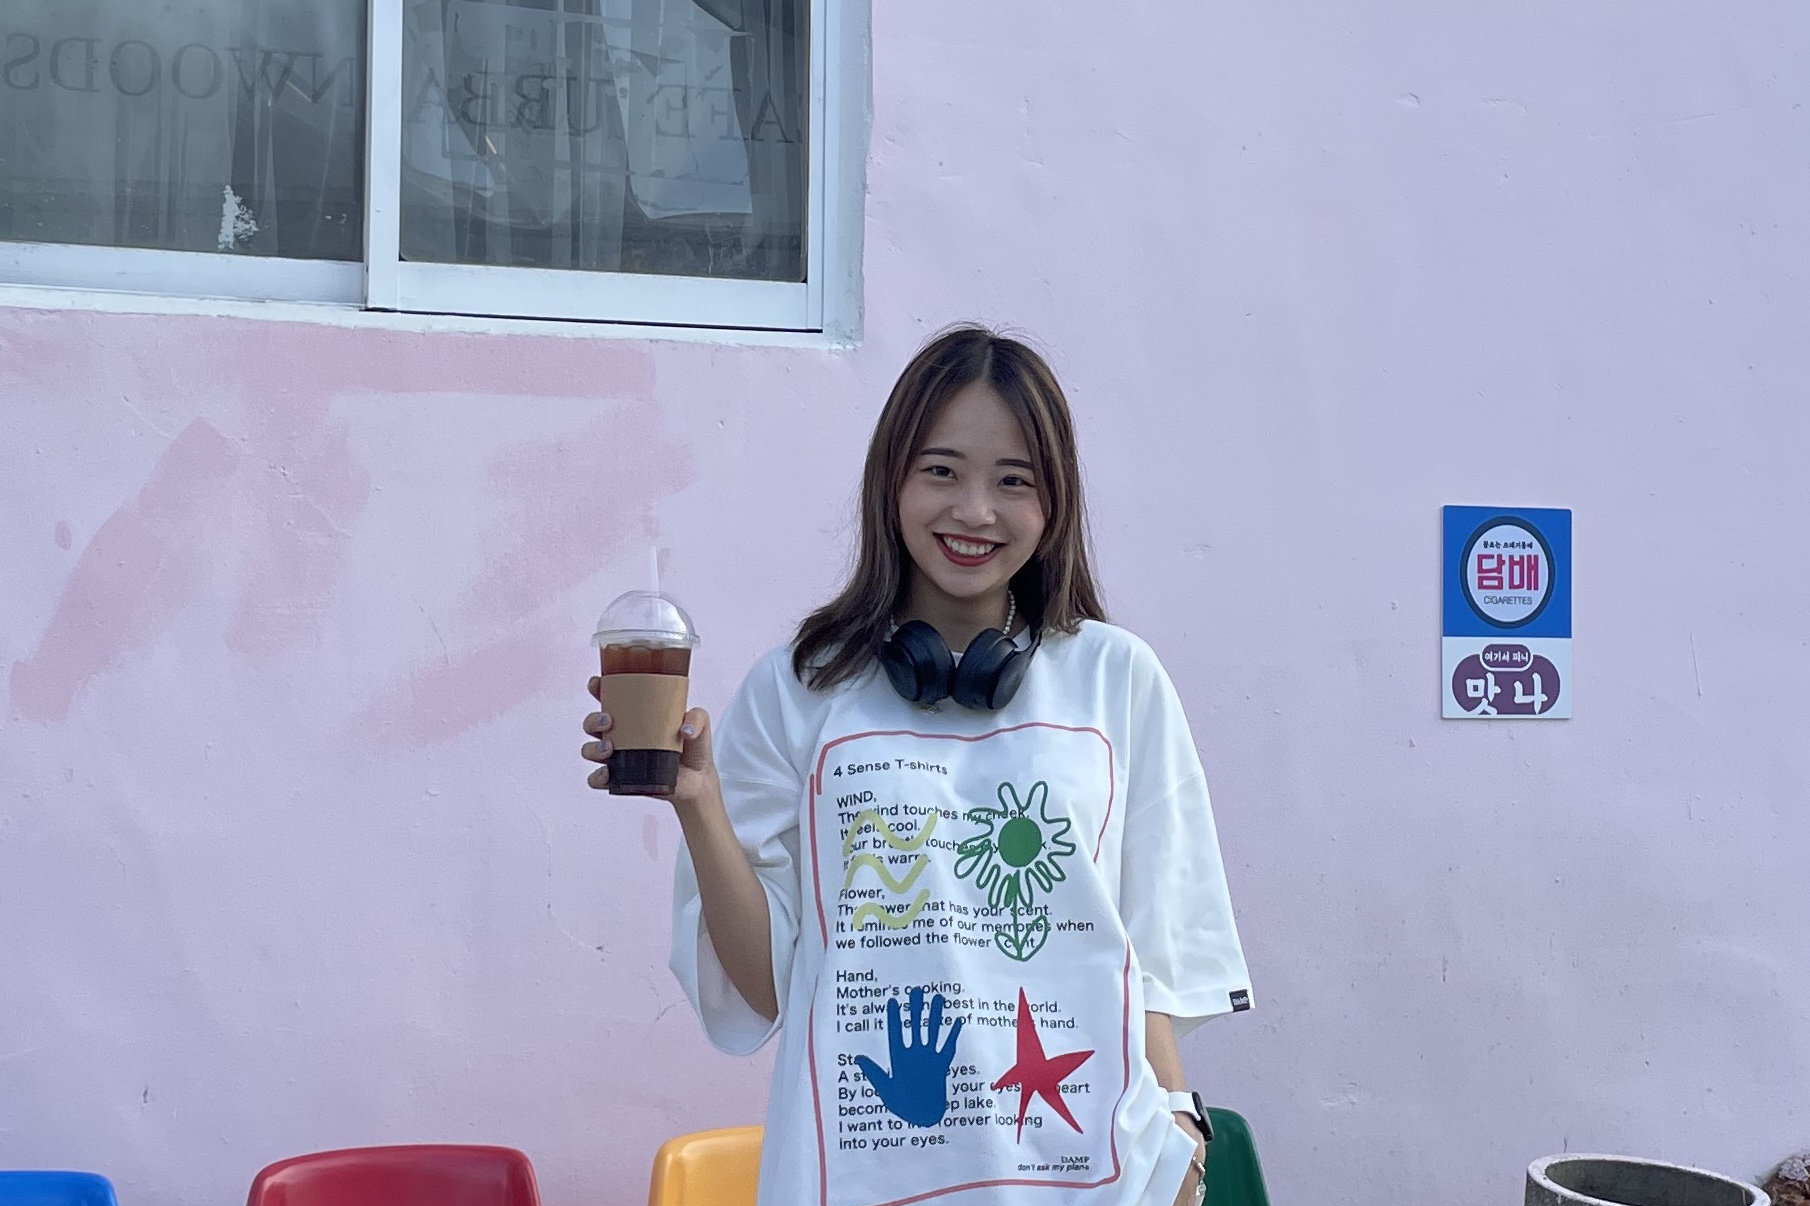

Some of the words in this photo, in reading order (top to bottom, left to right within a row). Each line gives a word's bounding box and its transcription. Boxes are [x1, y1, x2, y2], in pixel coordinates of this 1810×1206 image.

[1477, 553, 1539, 591] 담배
[1483, 595, 1533, 605] CIGARETTES
[1484, 651, 1510, 662] 여기서
[833, 766, 843, 777] 4
[847, 761, 891, 776] Sense
[894, 758, 948, 775] T-shirts
[836, 790, 877, 809] WIND,
[902, 804, 959, 820] touches
[949, 901, 969, 916] has
[973, 905, 1006, 919] your
[835, 920, 846, 933] It
[912, 919, 935, 929] me
[939, 916, 954, 927] of
[957, 920, 977, 931] our
[1056, 919, 1095, 931] when
[835, 939, 856, 950] we
[860, 933, 921, 948] followed
[925, 931, 949, 944] the
[953, 932, 991, 948] flower
[836, 969, 878, 982] Hand,
[836, 984, 900, 999] Mother's
[904, 980, 965, 995] coking.
[836, 1002, 857, 1016] It's
[992, 999, 1015, 1012] the
[1029, 1000, 1061, 1013] orld.
[836, 1020, 841, 1033] I
[845, 1018, 870, 1033] call
[873, 1017, 884, 1031] it
[1040, 1016, 1079, 1029] hand.
[838, 1070, 849, 1083] A
[838, 1087, 857, 1102] By
[952, 1081, 985, 1095] your
[964, 1096, 996, 1109] lake.
[838, 1121, 843, 1133] I
[847, 1119, 883, 1132] want
[887, 1119, 903, 1130] to
[872, 1136, 906, 1151] your
[910, 1135, 950, 1149] eyes.
[1060, 1155, 1091, 1163] DAMP
[1036, 1163, 1050, 1171] ask
[1051, 1164, 1064, 1172] my
